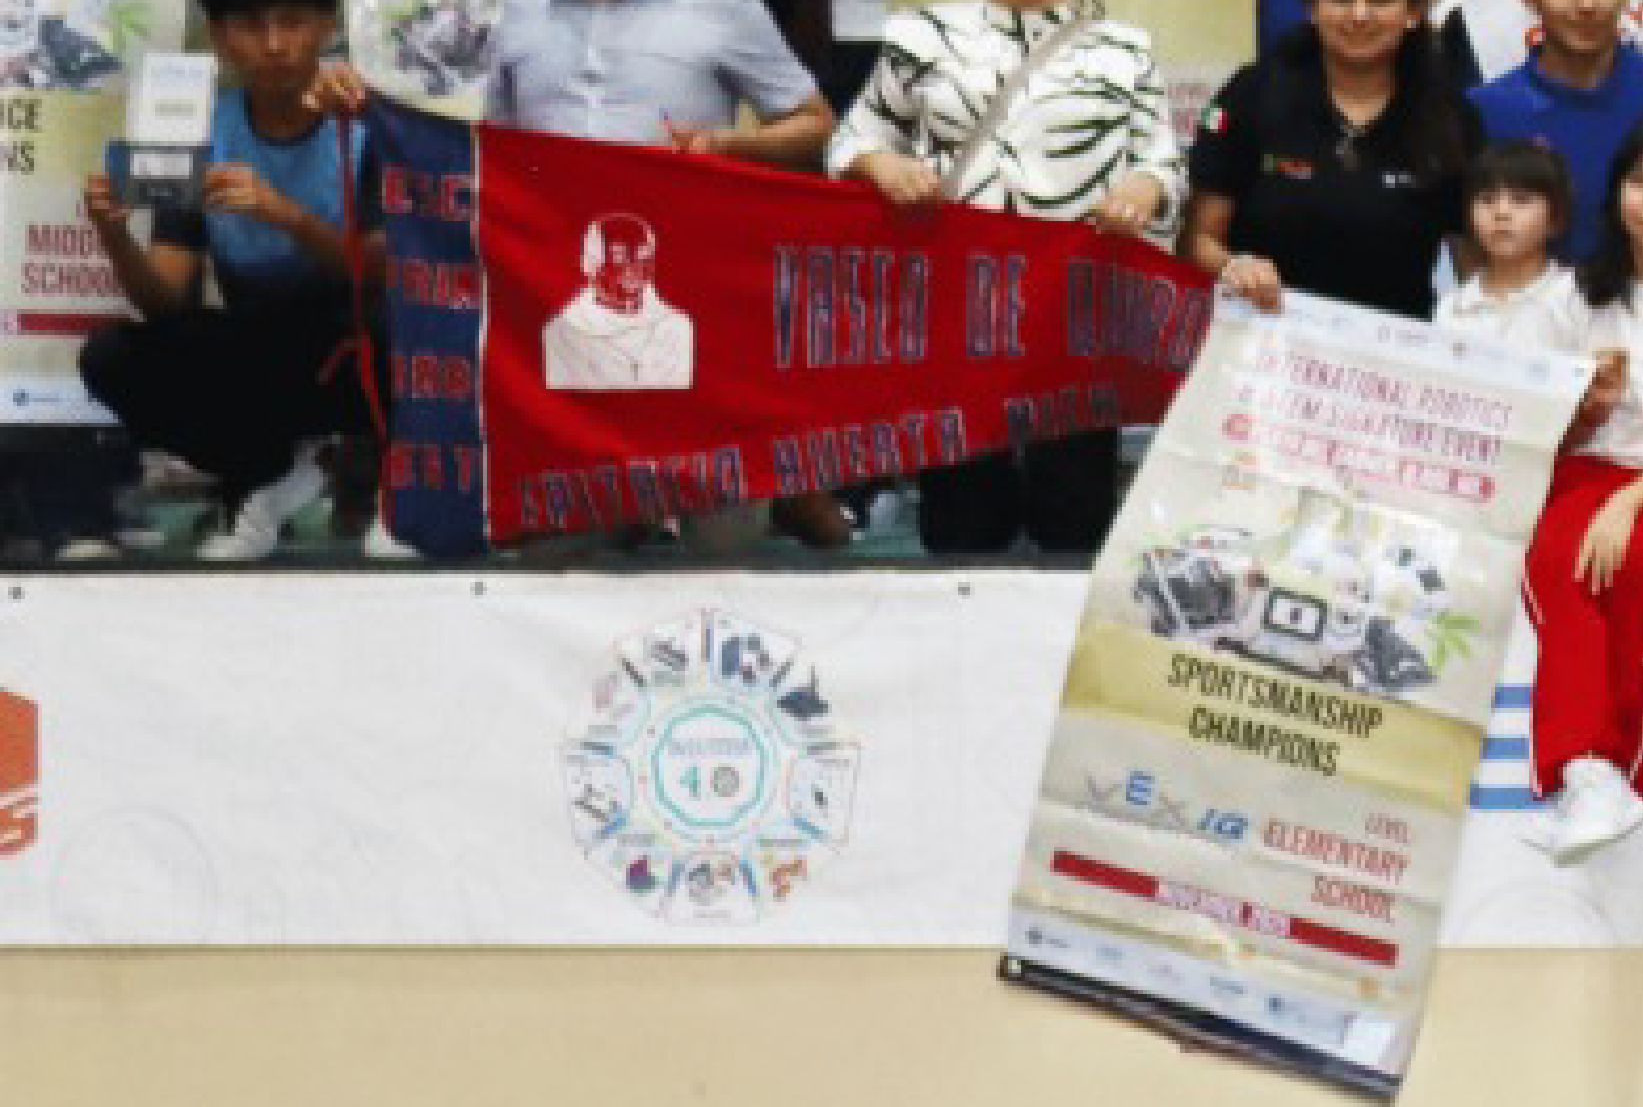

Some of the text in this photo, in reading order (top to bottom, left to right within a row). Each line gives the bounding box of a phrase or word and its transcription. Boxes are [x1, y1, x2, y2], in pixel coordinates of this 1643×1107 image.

[773, 244, 932, 369] VASCO
[966, 253, 1026, 359] DE
[1167, 653, 1384, 739] SPORTSMANSHIP
[1188, 707, 1342, 777] CHAMPIONS
[1262, 817, 1412, 886] ELEMENTARY
[1311, 875, 1395, 925] SCHOOL
